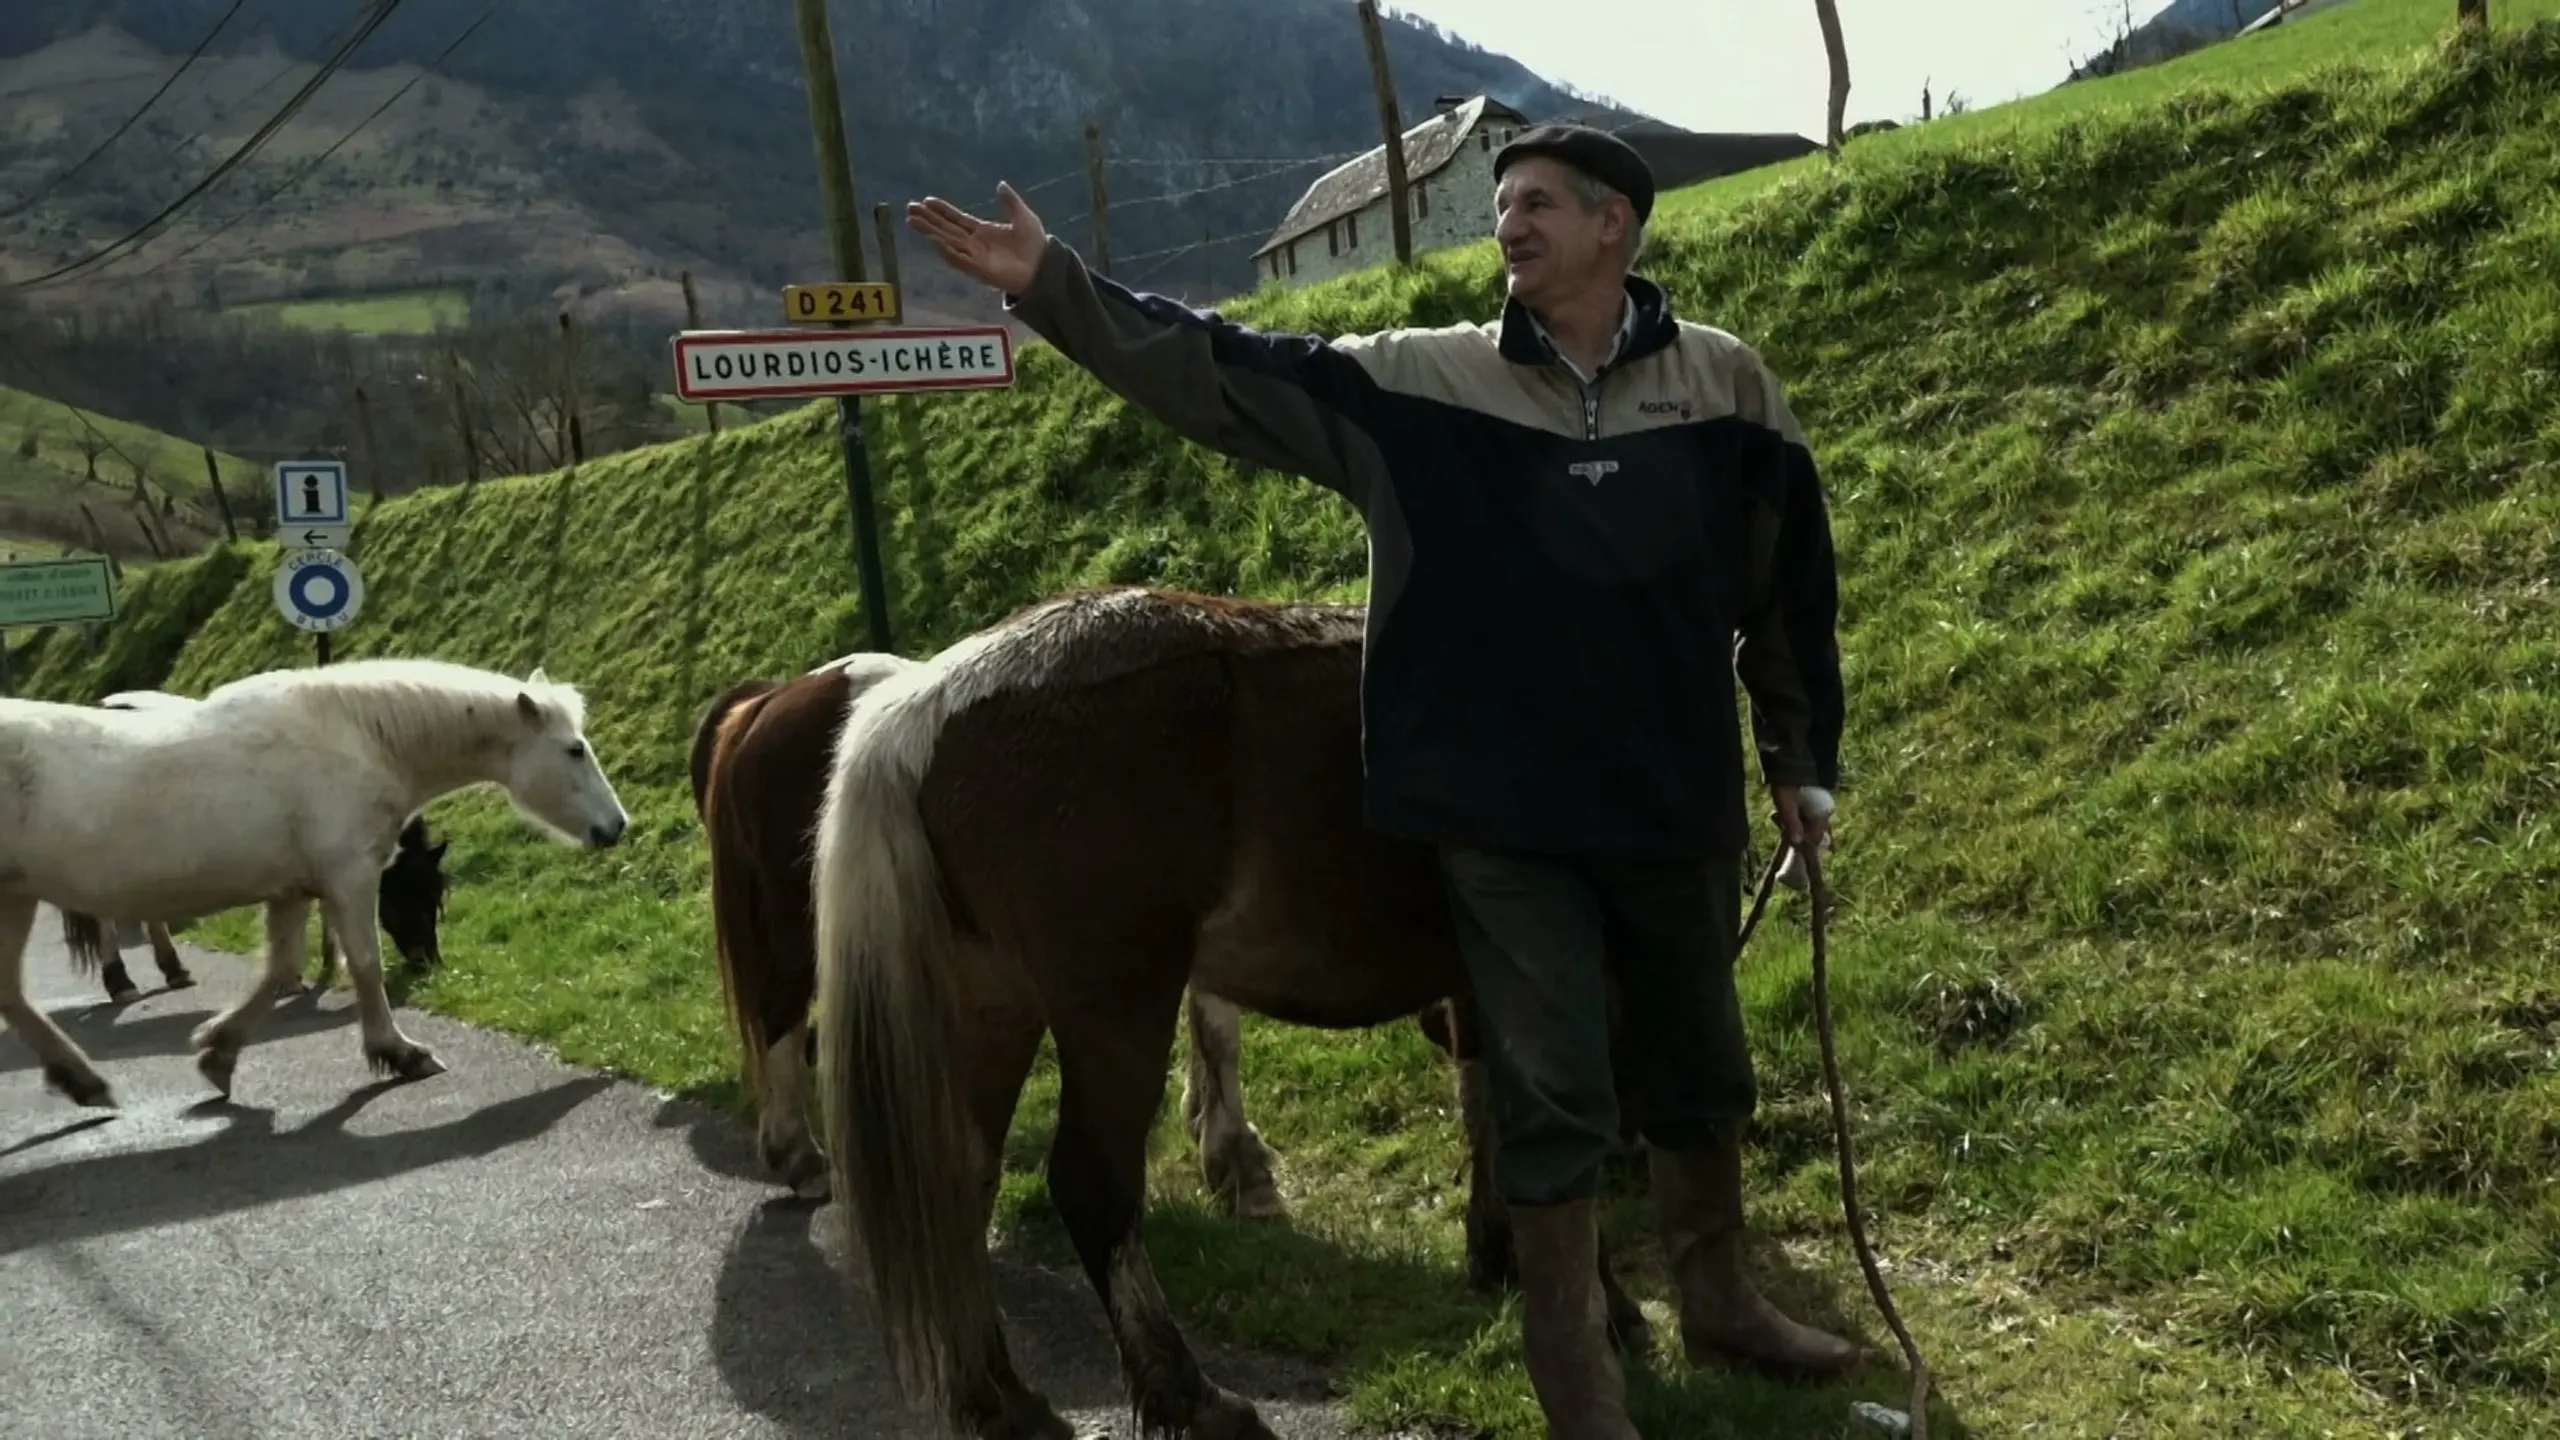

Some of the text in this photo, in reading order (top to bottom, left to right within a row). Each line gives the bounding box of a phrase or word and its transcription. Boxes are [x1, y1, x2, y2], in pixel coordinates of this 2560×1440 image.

[799, 289, 885, 316] D 241
[694, 340, 997, 380] LOURDIOS-ICHÈRE
[288, 552, 344, 571] CERCLE
[296, 611, 349, 630] BLEU
